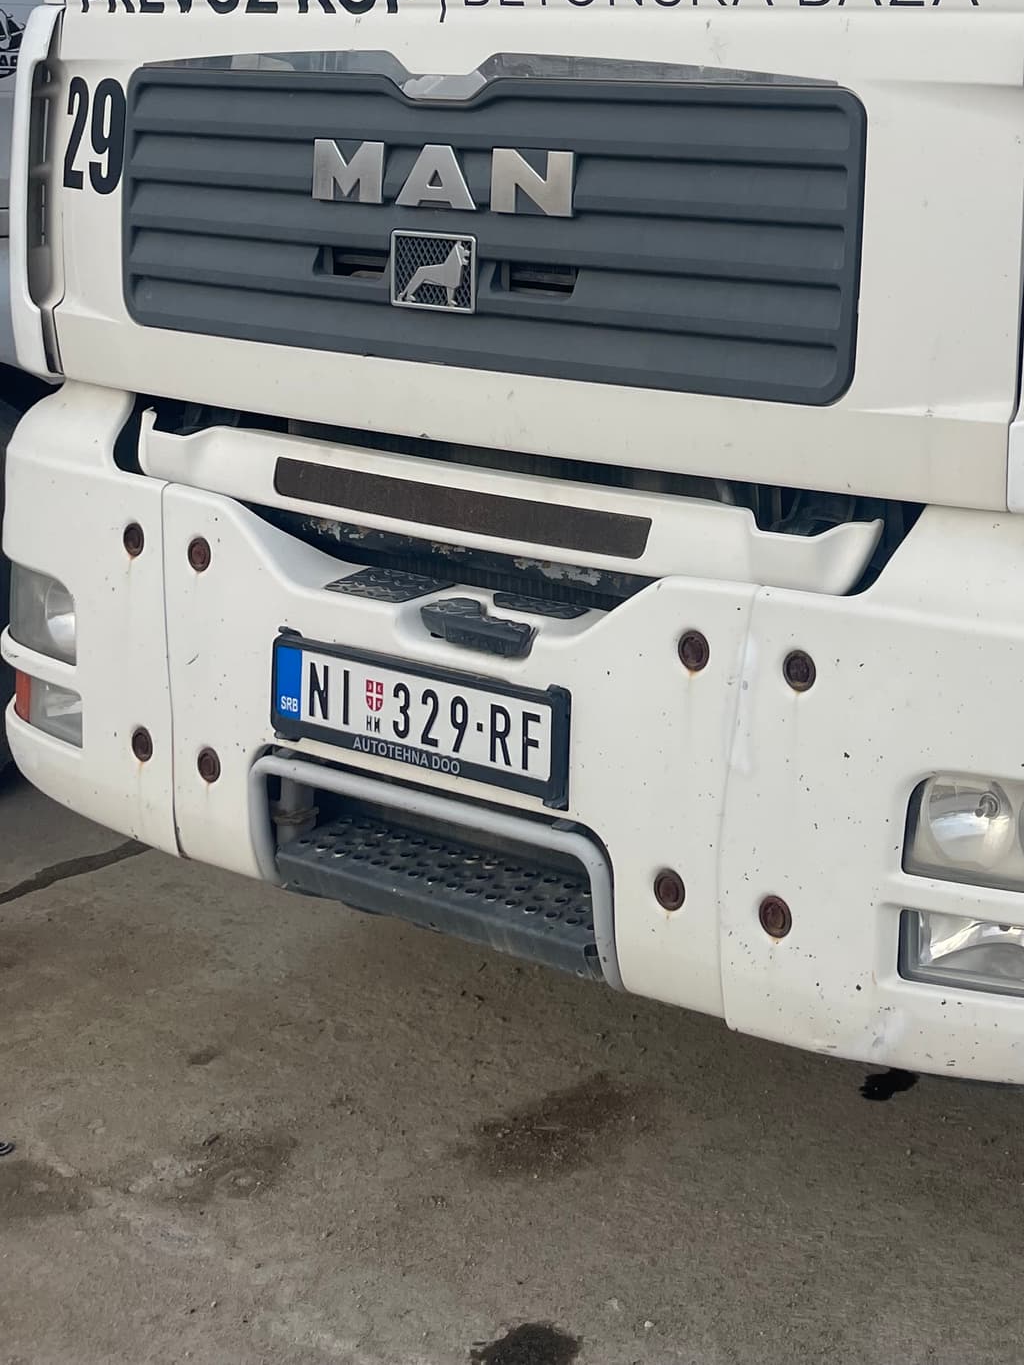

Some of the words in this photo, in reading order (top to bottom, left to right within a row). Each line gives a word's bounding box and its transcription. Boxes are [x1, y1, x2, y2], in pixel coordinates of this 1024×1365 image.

[62, 75, 127, 196] 29
[312, 137, 576, 218] MAN
[280, 695, 299, 713] SRB
[308, 662, 350, 725] NI
[352, 736, 430, 768] AUTOTEHNA
[431, 756, 461, 775] DOO
